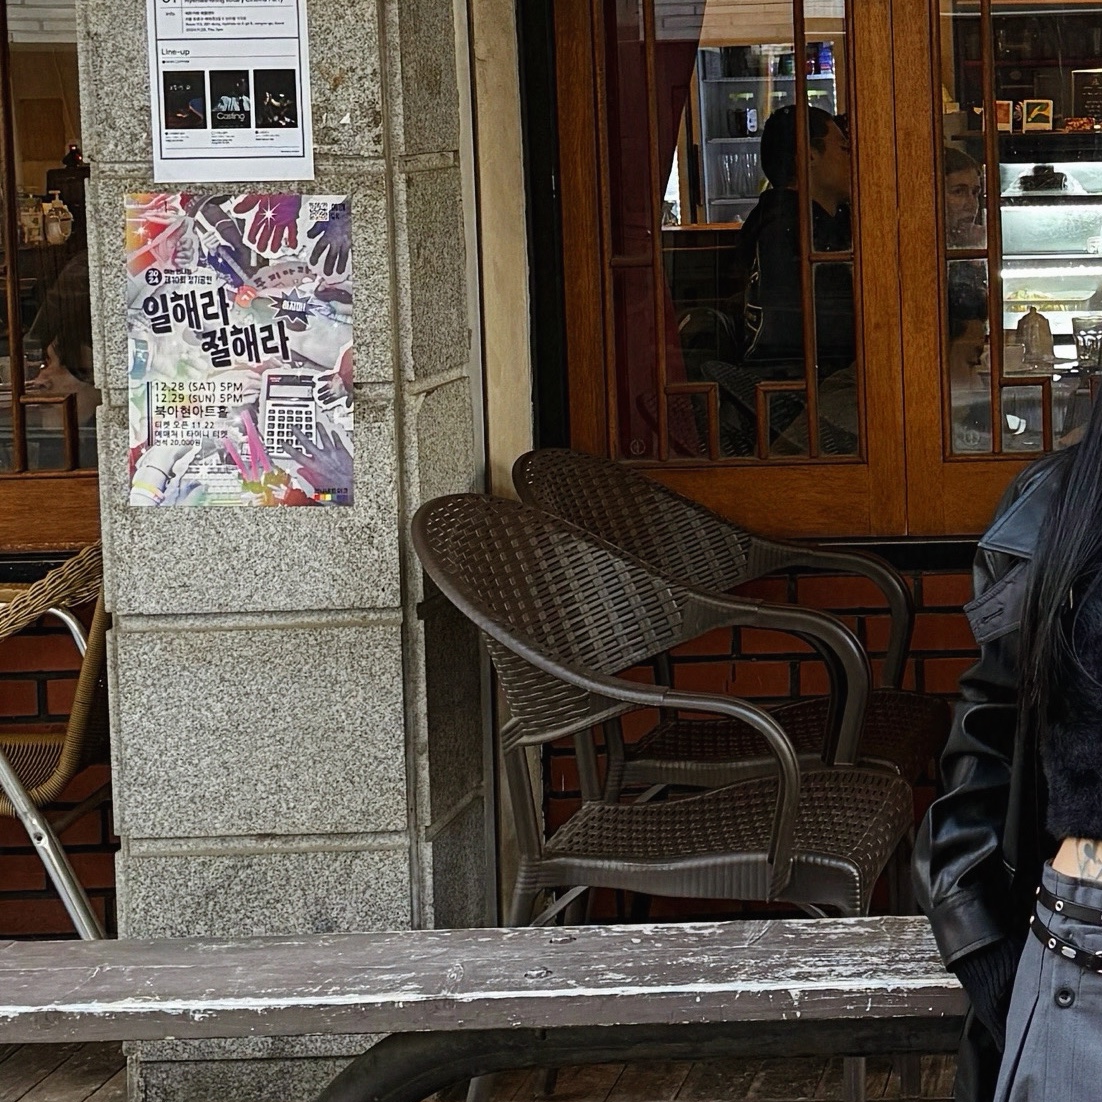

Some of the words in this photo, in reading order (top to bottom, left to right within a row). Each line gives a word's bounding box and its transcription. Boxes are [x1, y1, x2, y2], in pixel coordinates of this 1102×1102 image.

[161, 48, 190, 56] Line-up
[216, 111, 245, 122] Casting
[142, 286, 230, 335] 일해라
[201, 320, 290, 369] 절해라
[155, 382, 184, 392] 12.28
[188, 382, 216, 392] (SAT)
[220, 382, 243, 391] 5PM
[155, 393, 184, 403] 12.29
[188, 393, 216, 403] (SUN)
[220, 393, 243, 402] 5PM
[154, 405, 229, 418] 북아현아트홀
[173, 421, 189, 429] 오픈
